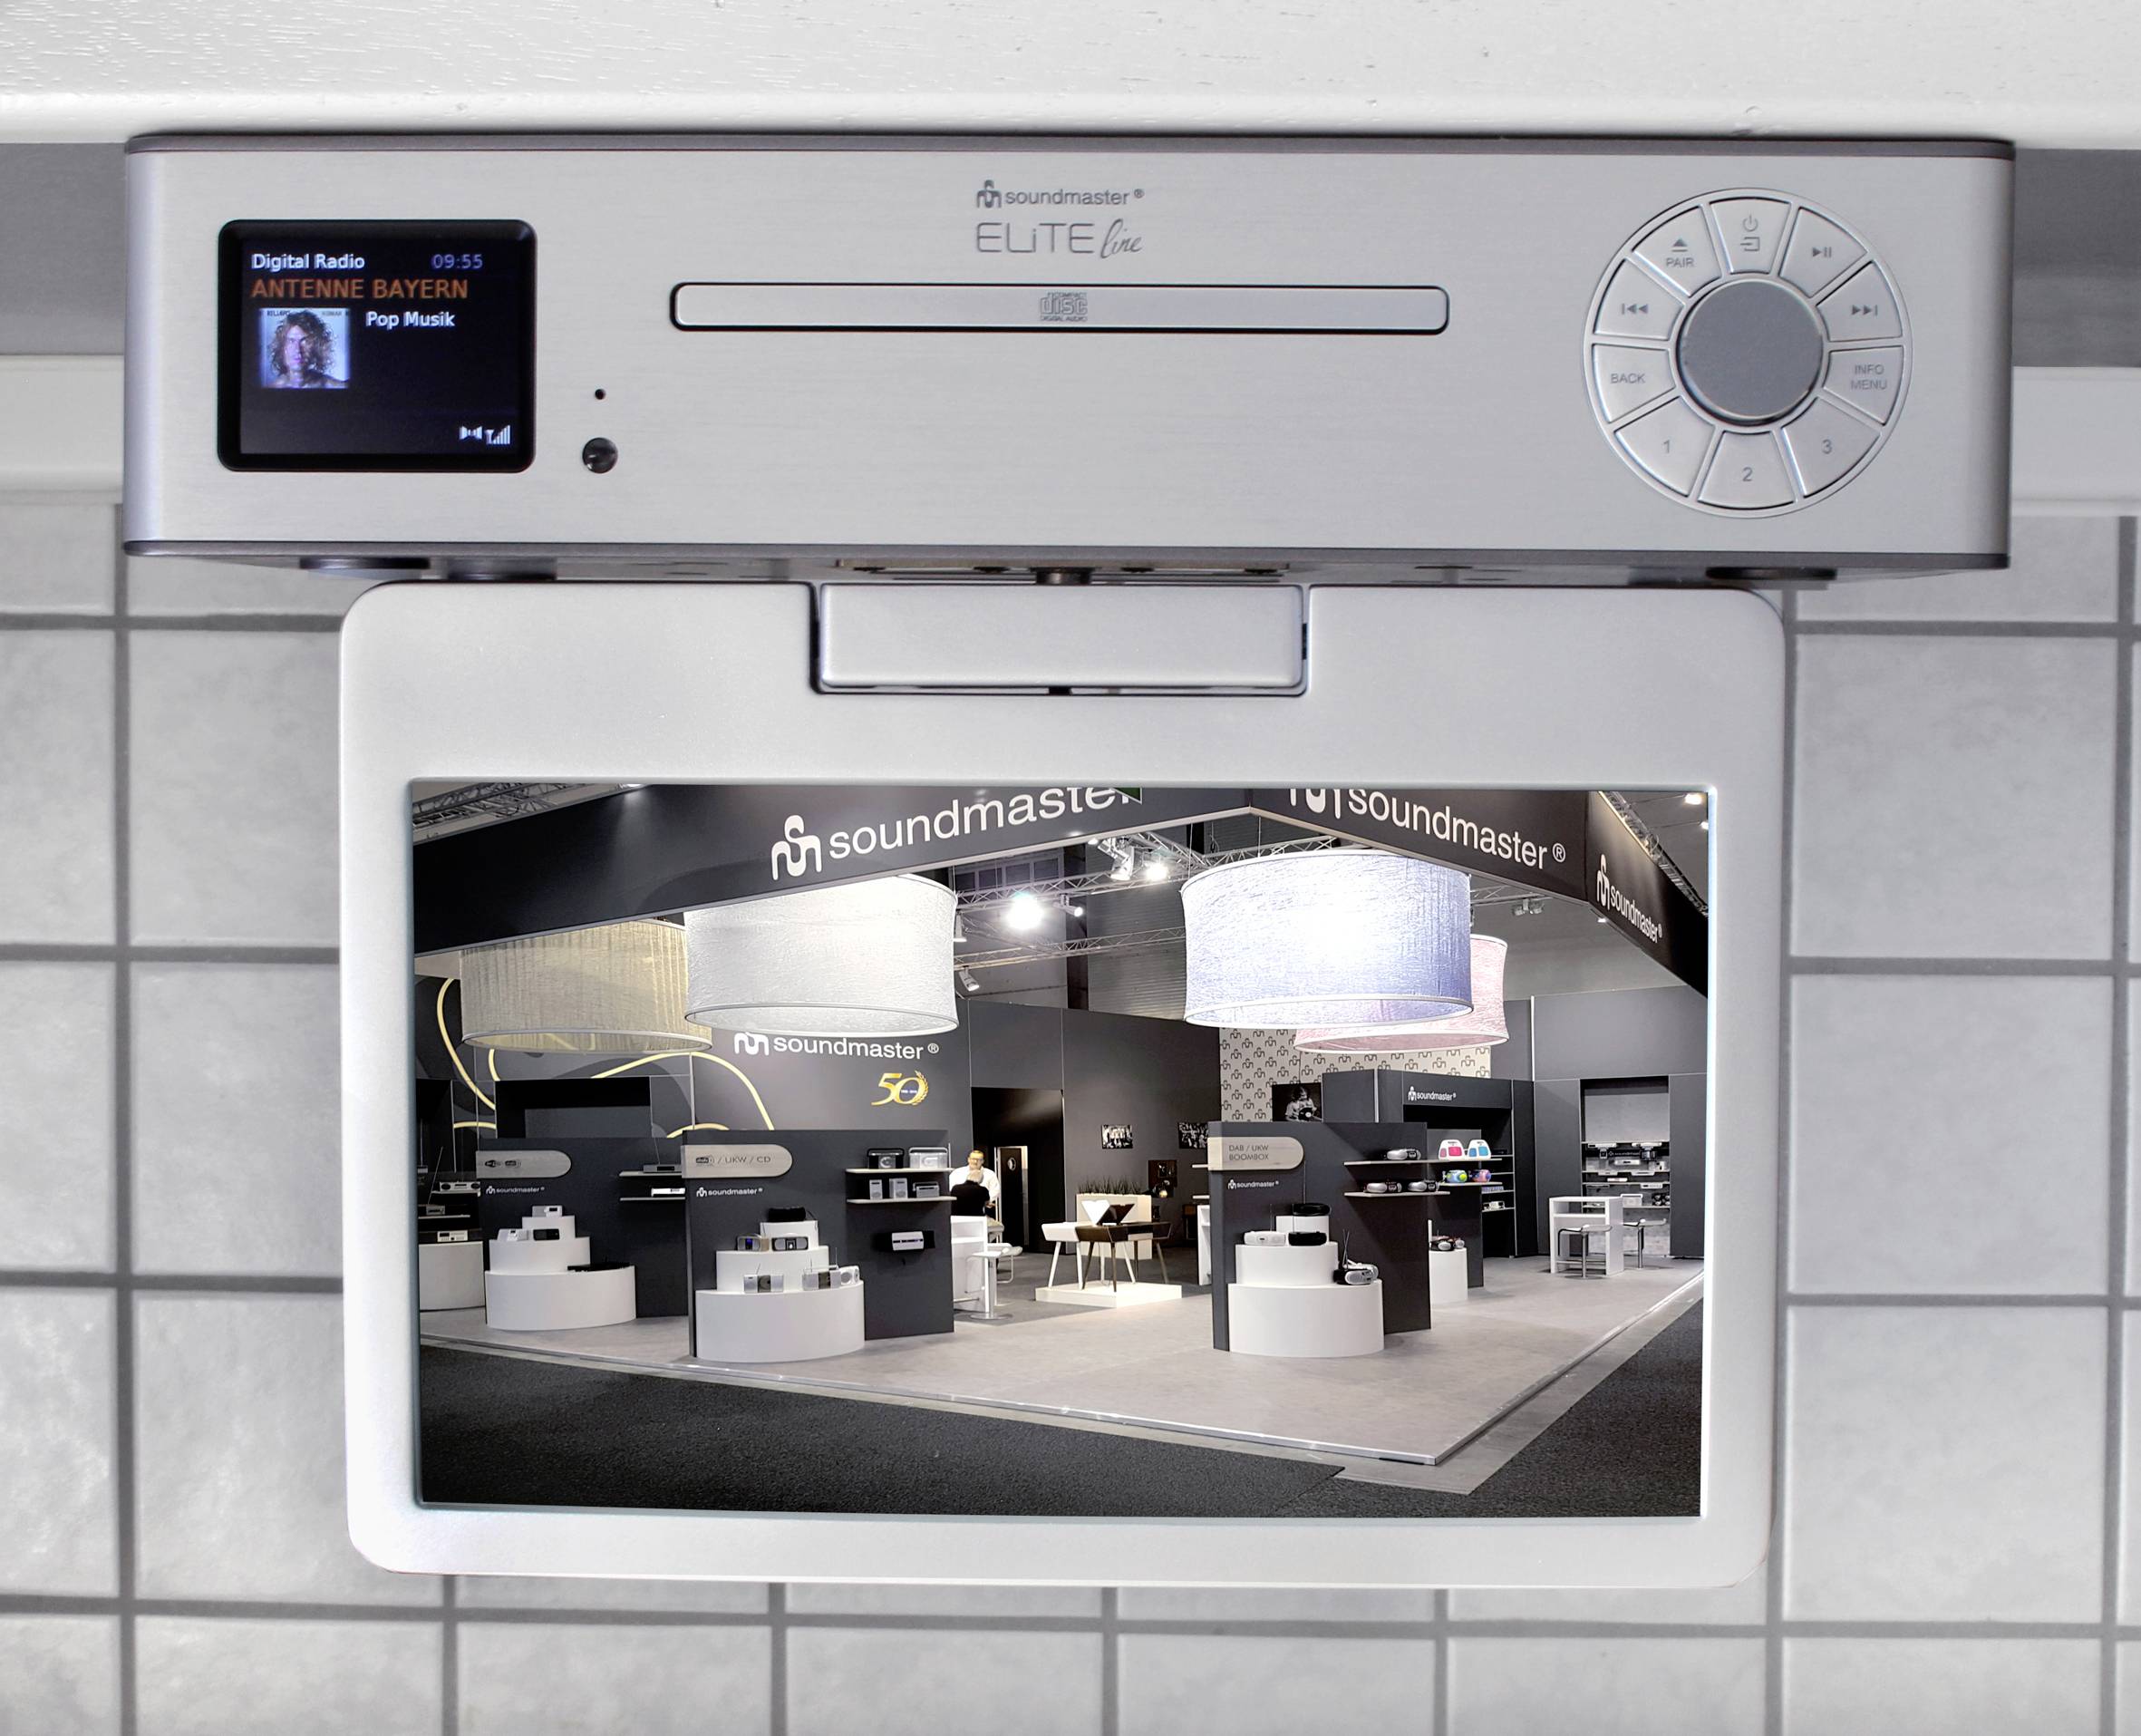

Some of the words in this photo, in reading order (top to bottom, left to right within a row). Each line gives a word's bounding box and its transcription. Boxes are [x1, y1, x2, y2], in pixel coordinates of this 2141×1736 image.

[976, 222, 1095, 254] ELiTE
[1100, 218, 1143, 259] line
[251, 253, 310, 272] Digital
[314, 253, 365, 269] Radio
[431, 253, 484, 269] 09:55
[1665, 256, 1695, 267] PAIR
[250, 278, 364, 299] ANTENNE
[372, 278, 469, 299] BAYERN
[365, 311, 400, 330] Pop
[403, 311, 456, 327] Musik
[1854, 364, 1884, 375] INFO
[1610, 373, 1646, 384] BACK
[1850, 379, 1887, 391] MENU
[1662, 441, 1671, 453] 1
[1822, 440, 1833, 454] 3
[1742, 467, 1753, 482] 2
[828, 787, 1130, 859] soundmaste
[871, 1072, 926, 1106] 50
[756, 1156, 771, 1164] CD
